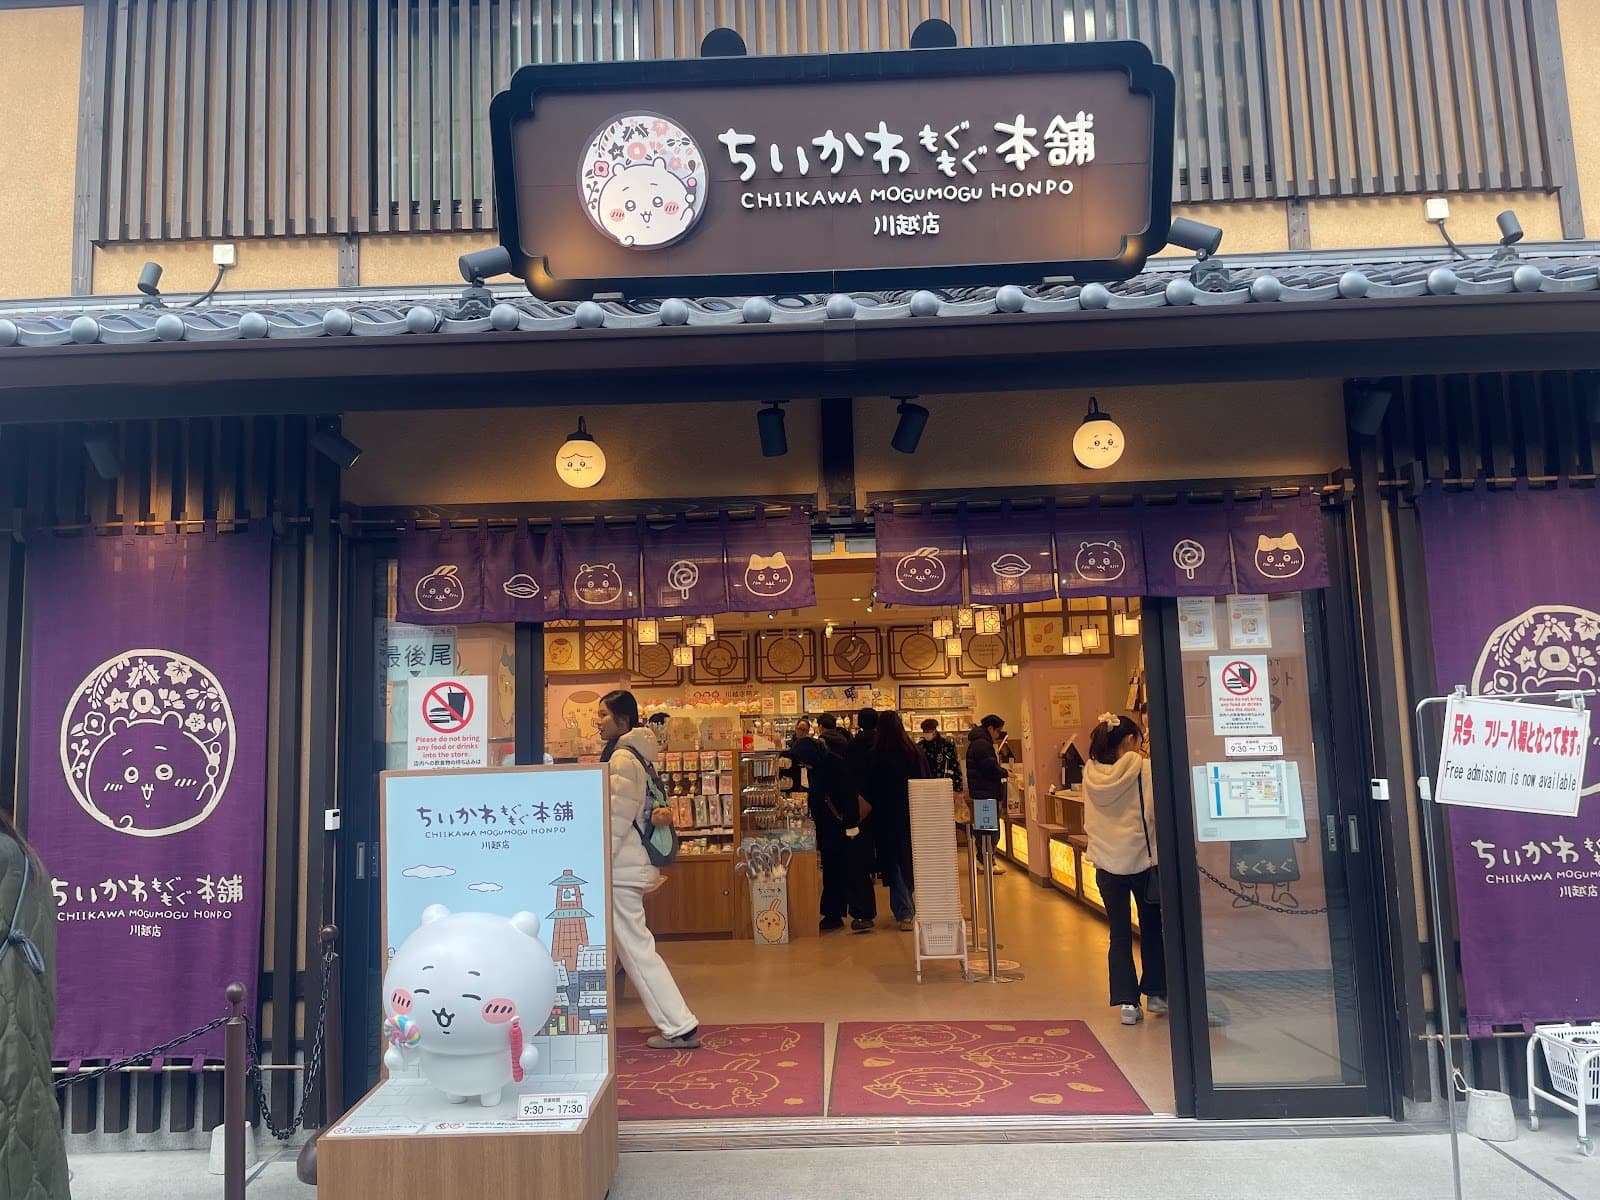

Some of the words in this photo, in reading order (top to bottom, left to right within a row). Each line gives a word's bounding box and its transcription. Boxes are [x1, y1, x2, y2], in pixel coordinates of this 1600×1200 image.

[741, 187, 862, 209] CHIIKAWA
[870, 185, 983, 204] MOGUMOGU
[991, 179, 1074, 199] HONPO
[873, 211, 940, 237] 川越店
[1258, 744, 1278, 752] 17:30
[1445, 760, 1464, 779] Free
[1467, 763, 1506, 785] admission
[1511, 768, 1519, 785] is
[1522, 773, 1537, 788] now
[1539, 771, 1577, 792] available
[425, 830, 477, 839] CHIIKAWA
[480, 828, 528, 836] MOGUMOGU
[531, 826, 566, 835] HONPO
[481, 840, 510, 850] 川越店
[1236, 859, 1293, 876] もぐもぐ
[1485, 871, 1552, 884] CHIIKAWA
[1559, 884, 1598, 897] 川越店
[57, 909, 125, 921] CHIIKAWA
[129, 909, 189, 920] MOGUMOGU
[194, 909, 232, 919] HONPO
[129, 924, 161, 937] 川越店
[524, 1105, 544, 1114] 9:30
[558, 1104, 583, 1114] 17:30
